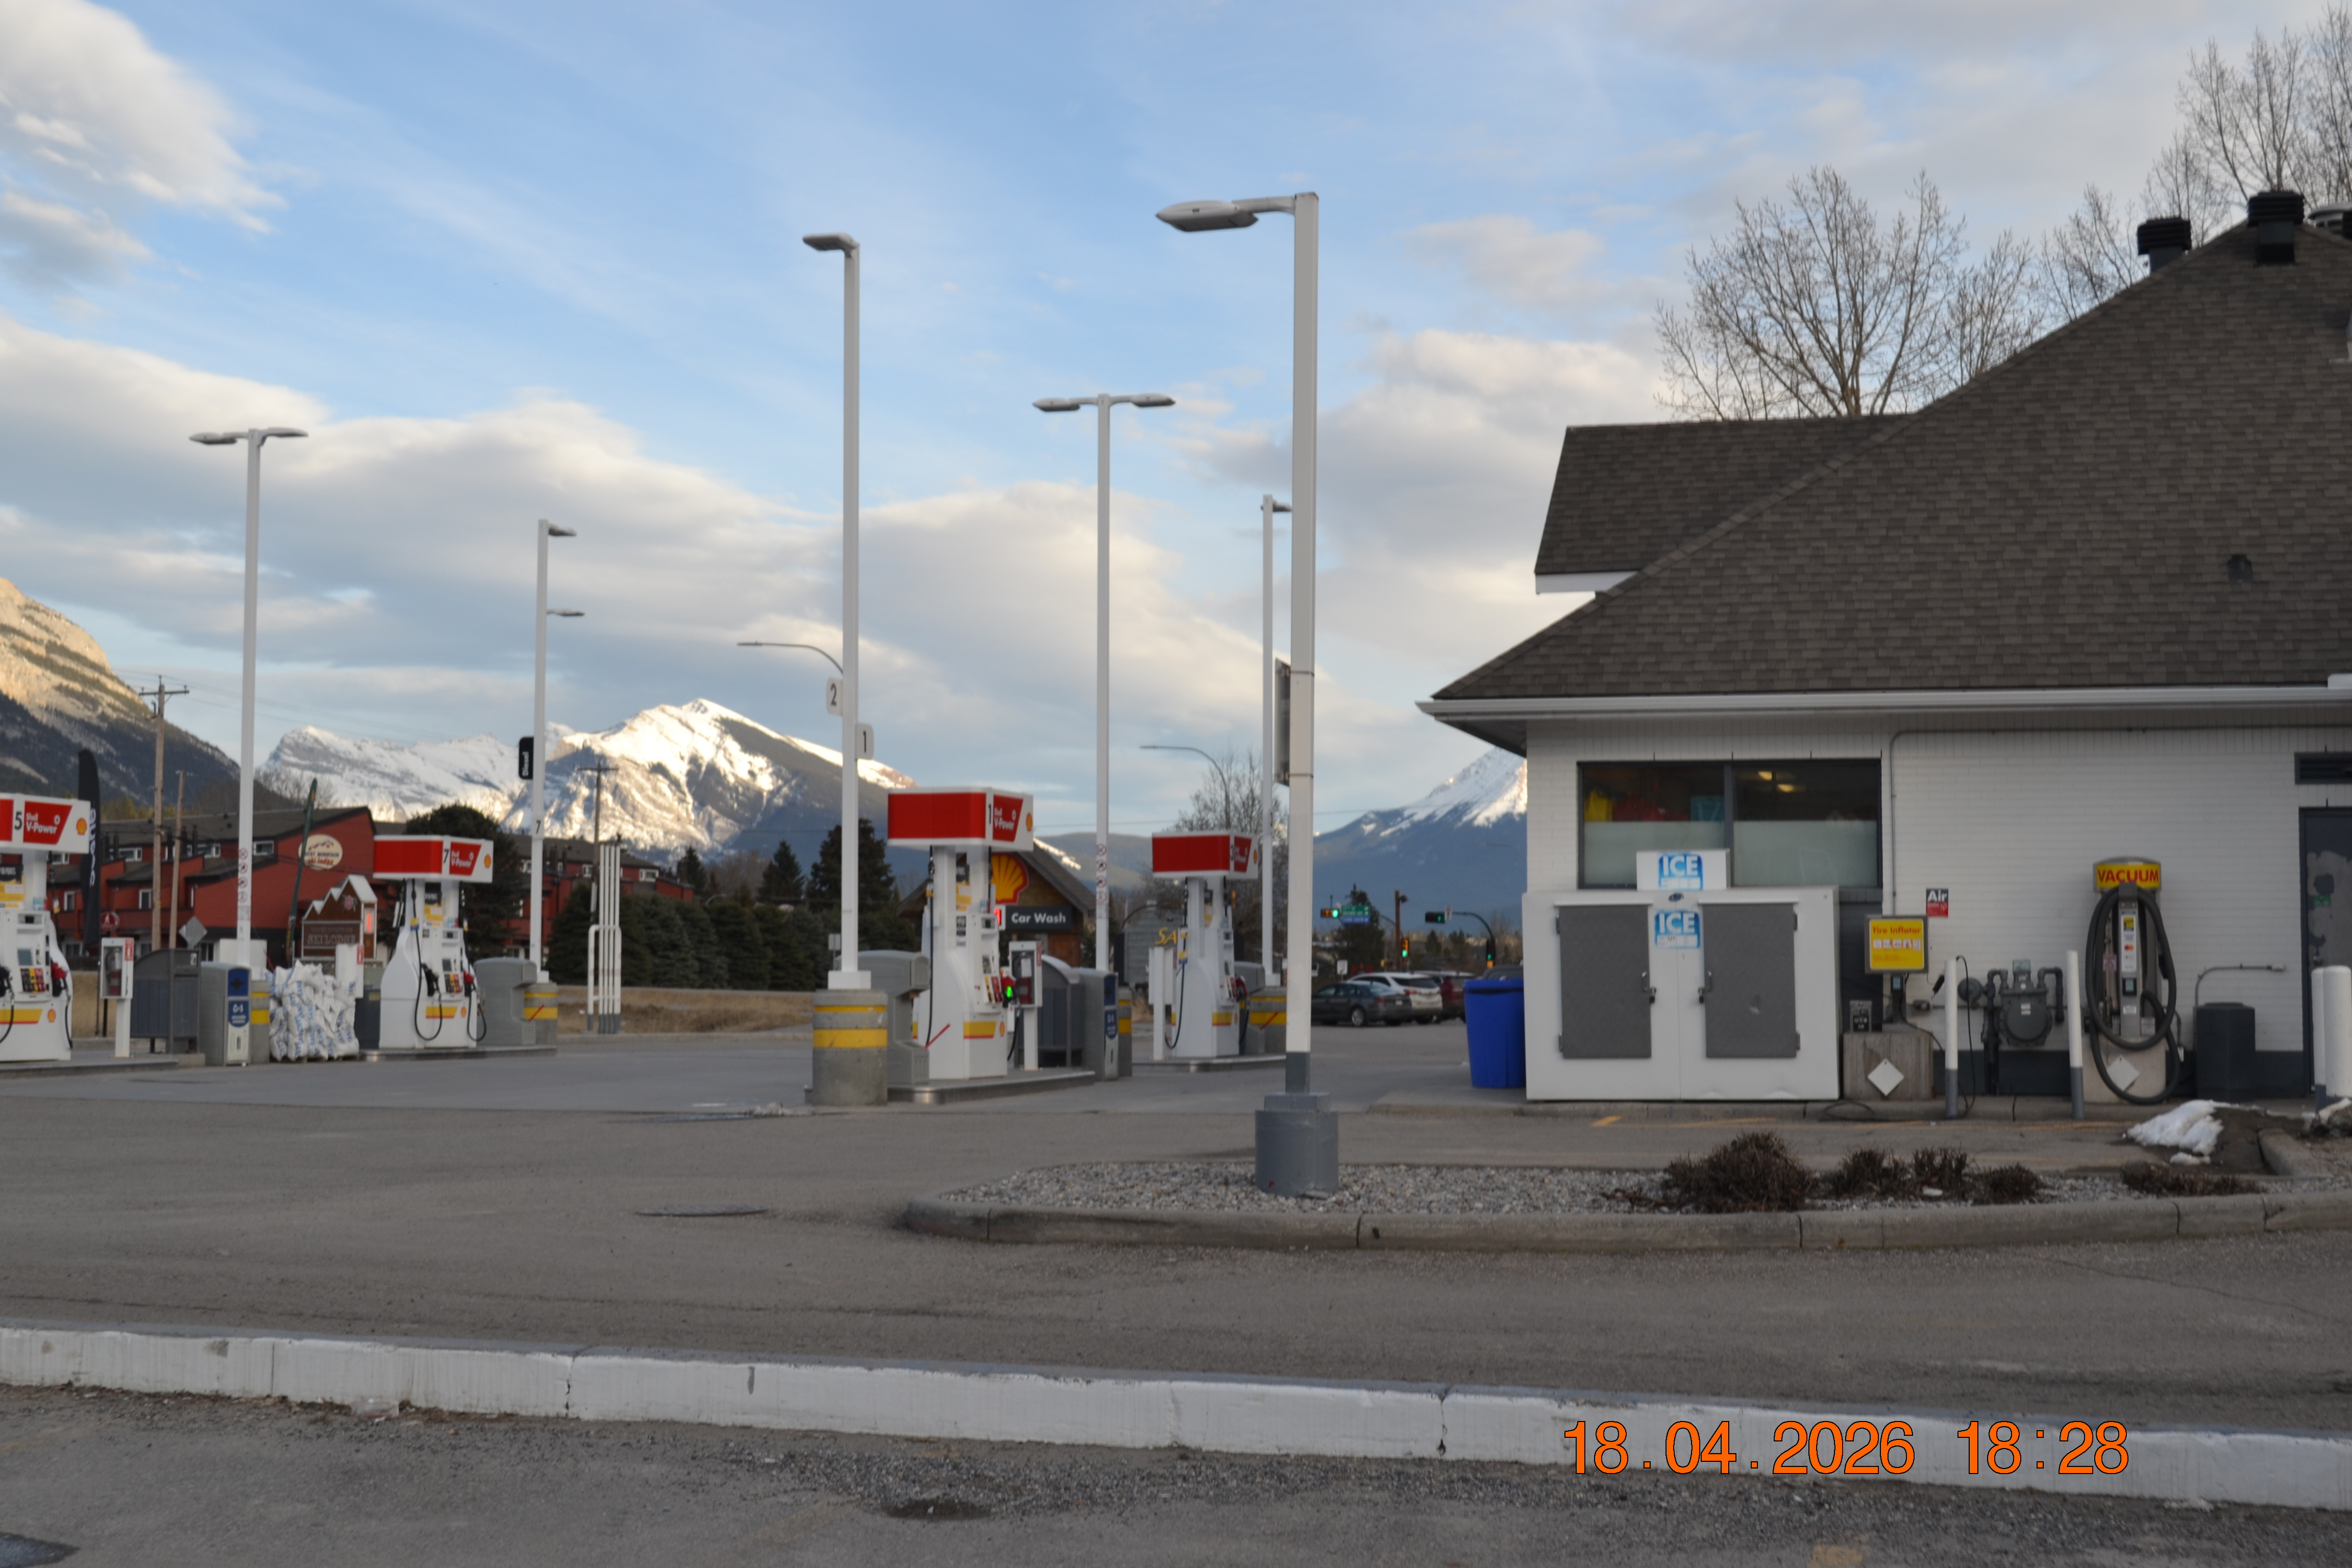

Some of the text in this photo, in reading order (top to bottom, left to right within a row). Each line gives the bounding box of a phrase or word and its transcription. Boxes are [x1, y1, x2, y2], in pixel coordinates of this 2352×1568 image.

[830, 682, 837, 706] 2
[863, 730, 867, 753] 1
[14, 811, 23, 830] 5
[988, 803, 992, 825] 1
[26, 821, 58, 835] V-Power
[536, 820, 542, 834] 7
[994, 817, 1015, 830] V-Power
[444, 849, 450, 864] 7
[1663, 855, 1698, 877] ICE
[2098, 869, 2159, 883] VACUUM
[1927, 890, 1947, 902] Air
[1011, 912, 1066, 924] Car Wash
[1659, 912, 1695, 934] ICE
[1890, 926, 1921, 934] Inflator
